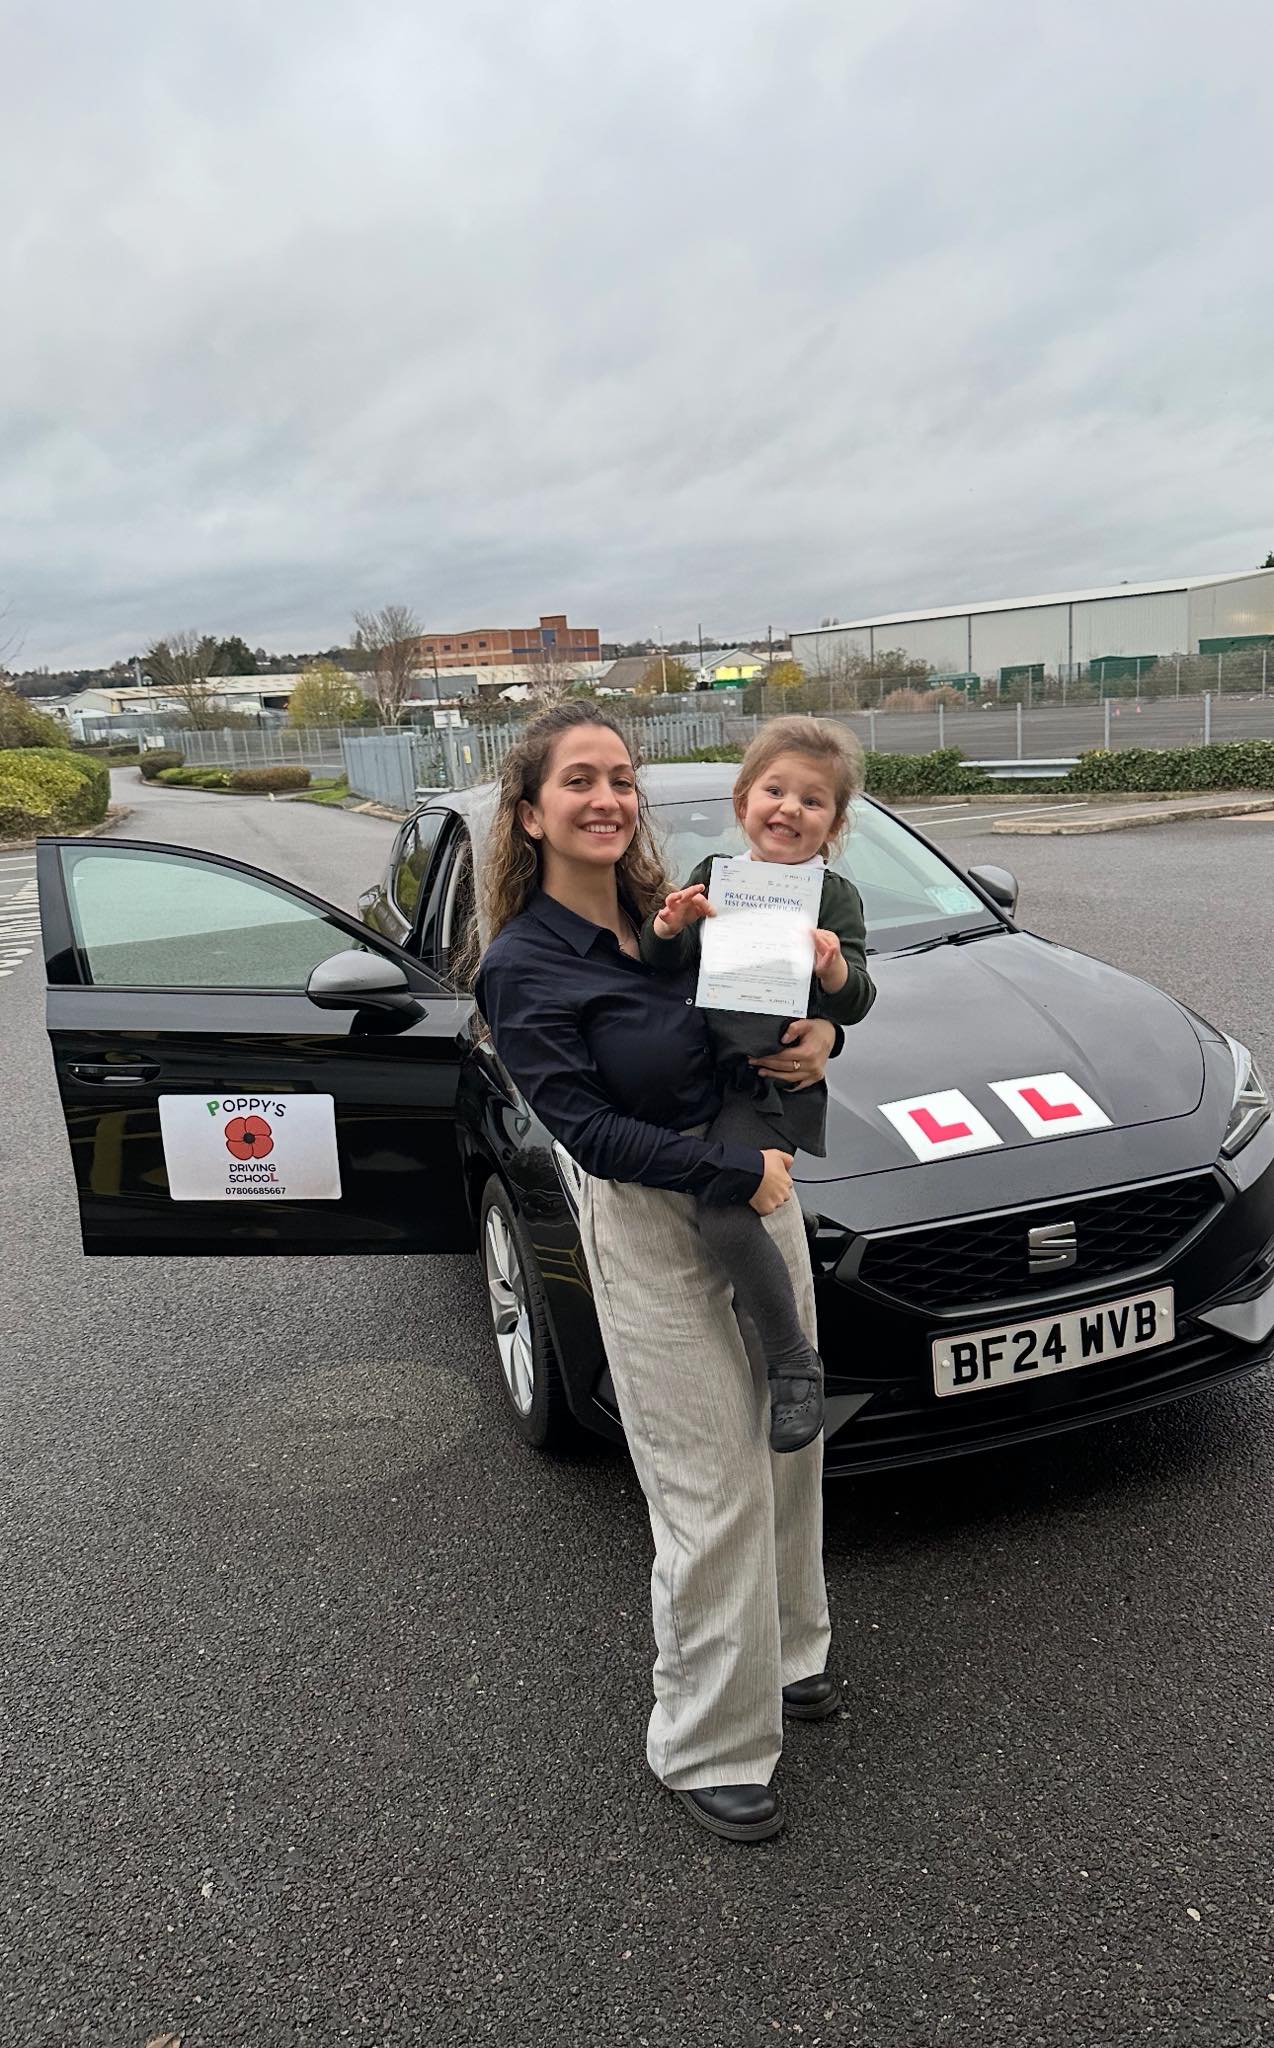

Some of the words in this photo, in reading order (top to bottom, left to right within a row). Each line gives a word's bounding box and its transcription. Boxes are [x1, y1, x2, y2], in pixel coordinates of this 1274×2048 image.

[724, 892, 765, 902] PRACTICAL
[724, 899, 739, 907] TEST
[740, 900, 757, 909] PASS
[206, 1098, 287, 1117] POPPY'S
[1018, 1087, 1083, 1121] L
[907, 1107, 974, 1144] L
[229, 1164, 276, 1172] DRIVING
[229, 1173, 278, 1182] SCHOOL
[225, 1187, 286, 1195] 07806685667
[950, 1322, 1067, 1386] BF24
[1080, 1299, 1157, 1358] WVB
